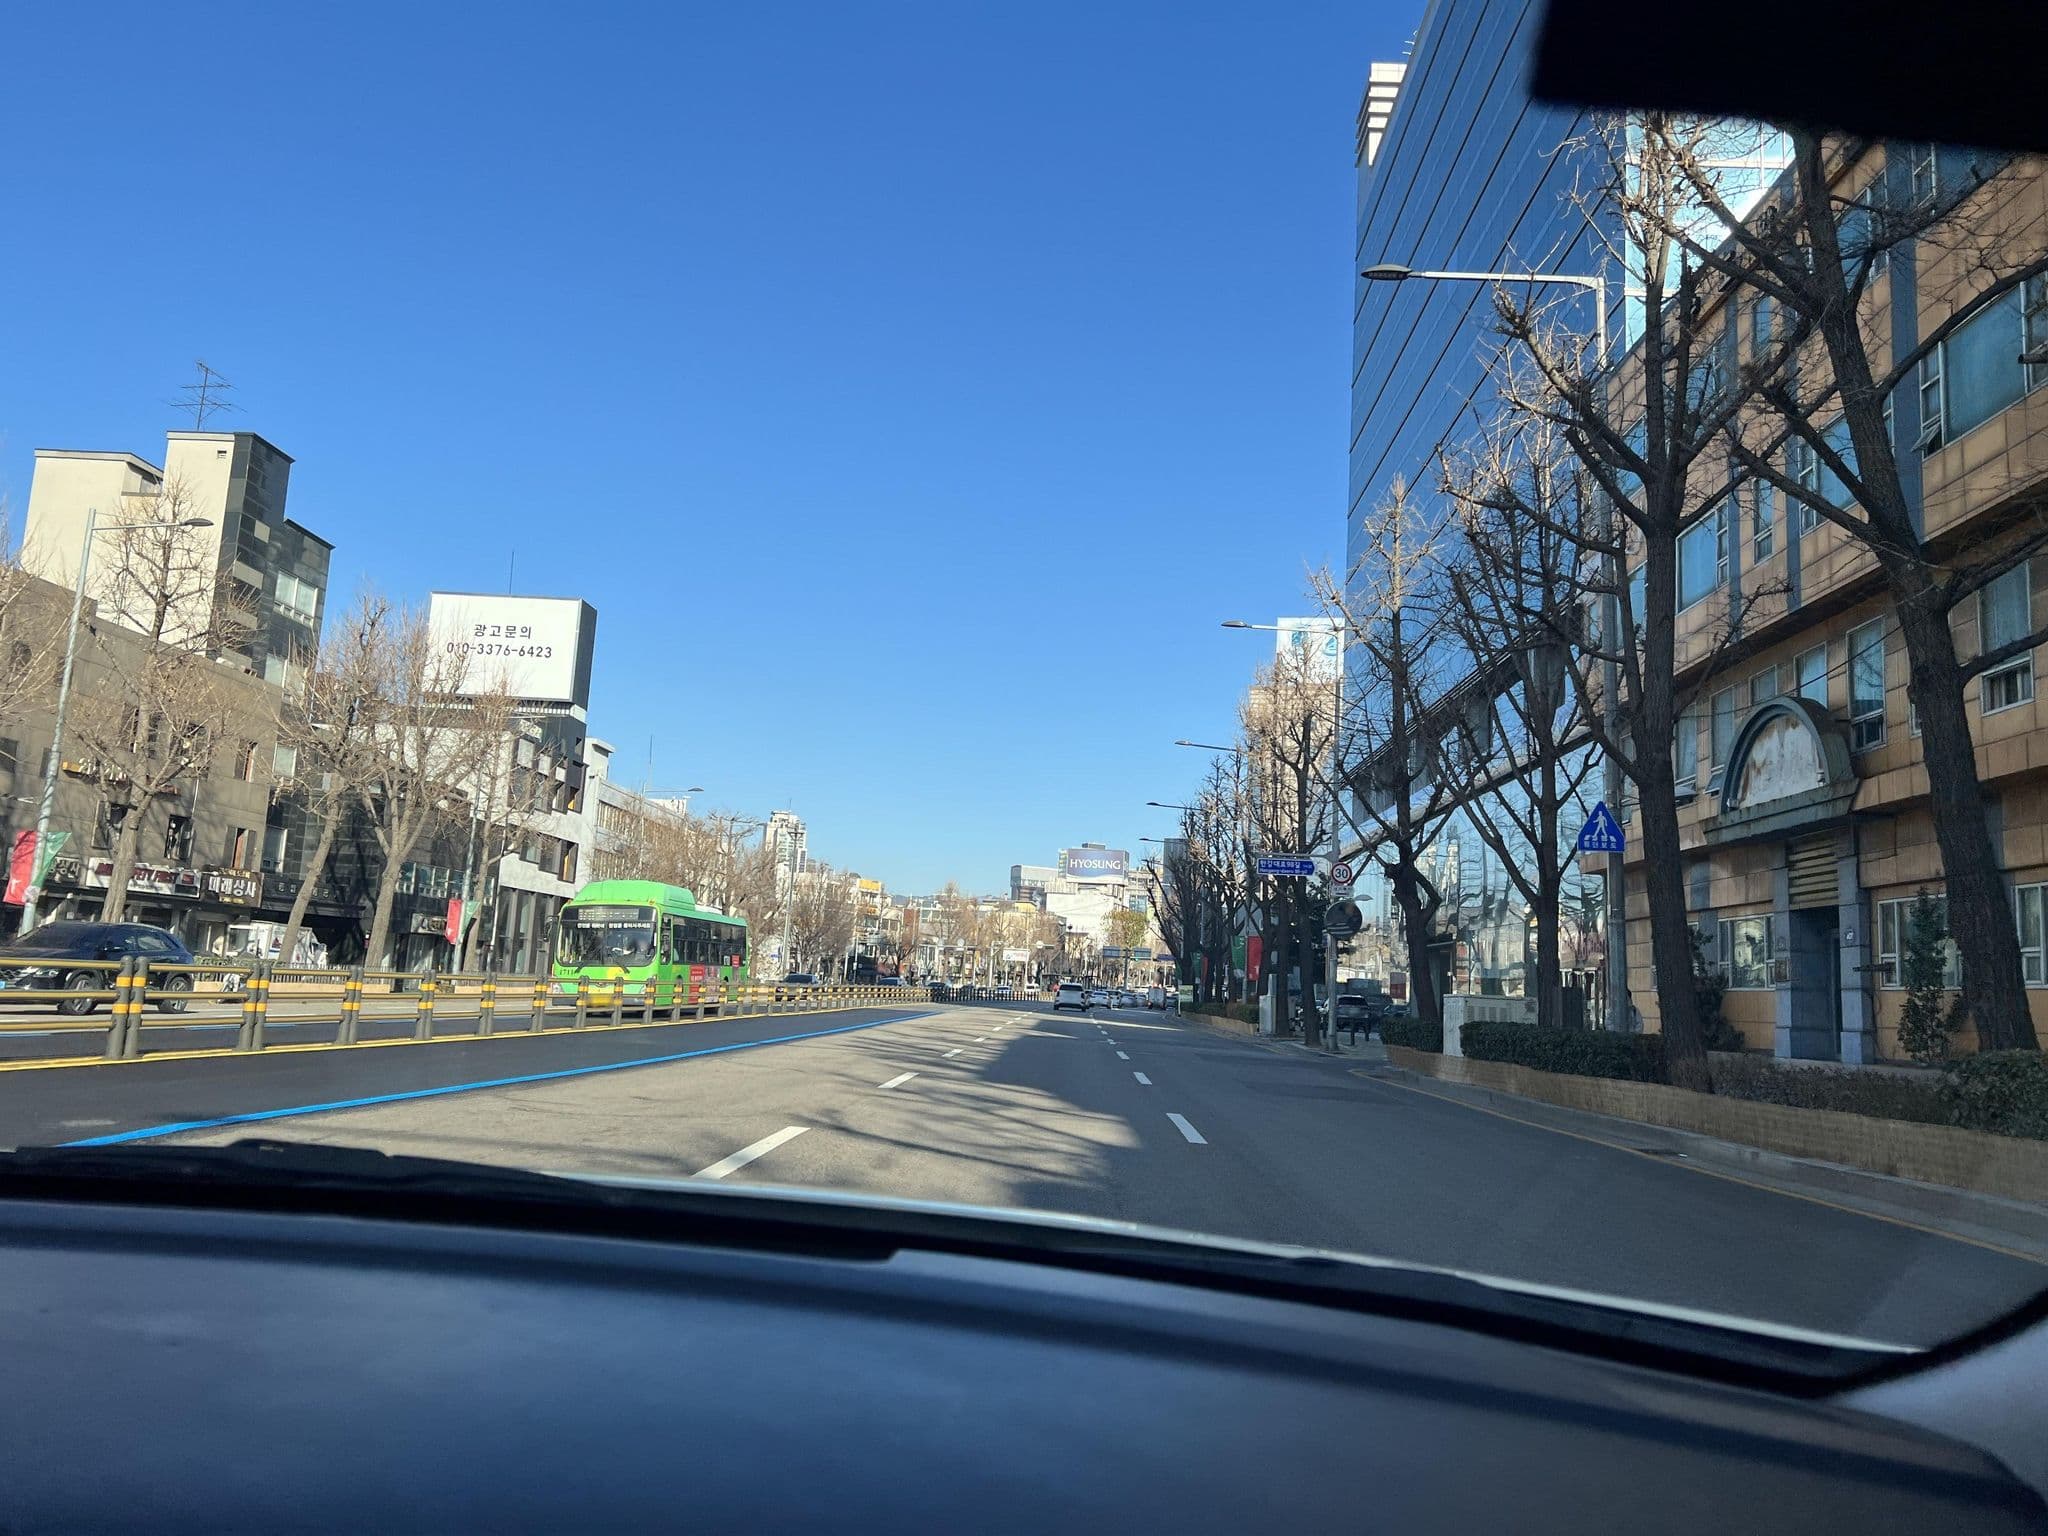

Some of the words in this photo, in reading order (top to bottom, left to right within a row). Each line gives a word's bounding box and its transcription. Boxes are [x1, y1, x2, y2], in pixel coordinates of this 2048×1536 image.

[474, 624, 532, 639] 광고문의
[446, 642, 552, 659] 010-3376-6423
[1069, 858, 1121, 870] HYOSUNG
[1335, 868, 1349, 878] 30
[208, 876, 257, 898] 미래상사
